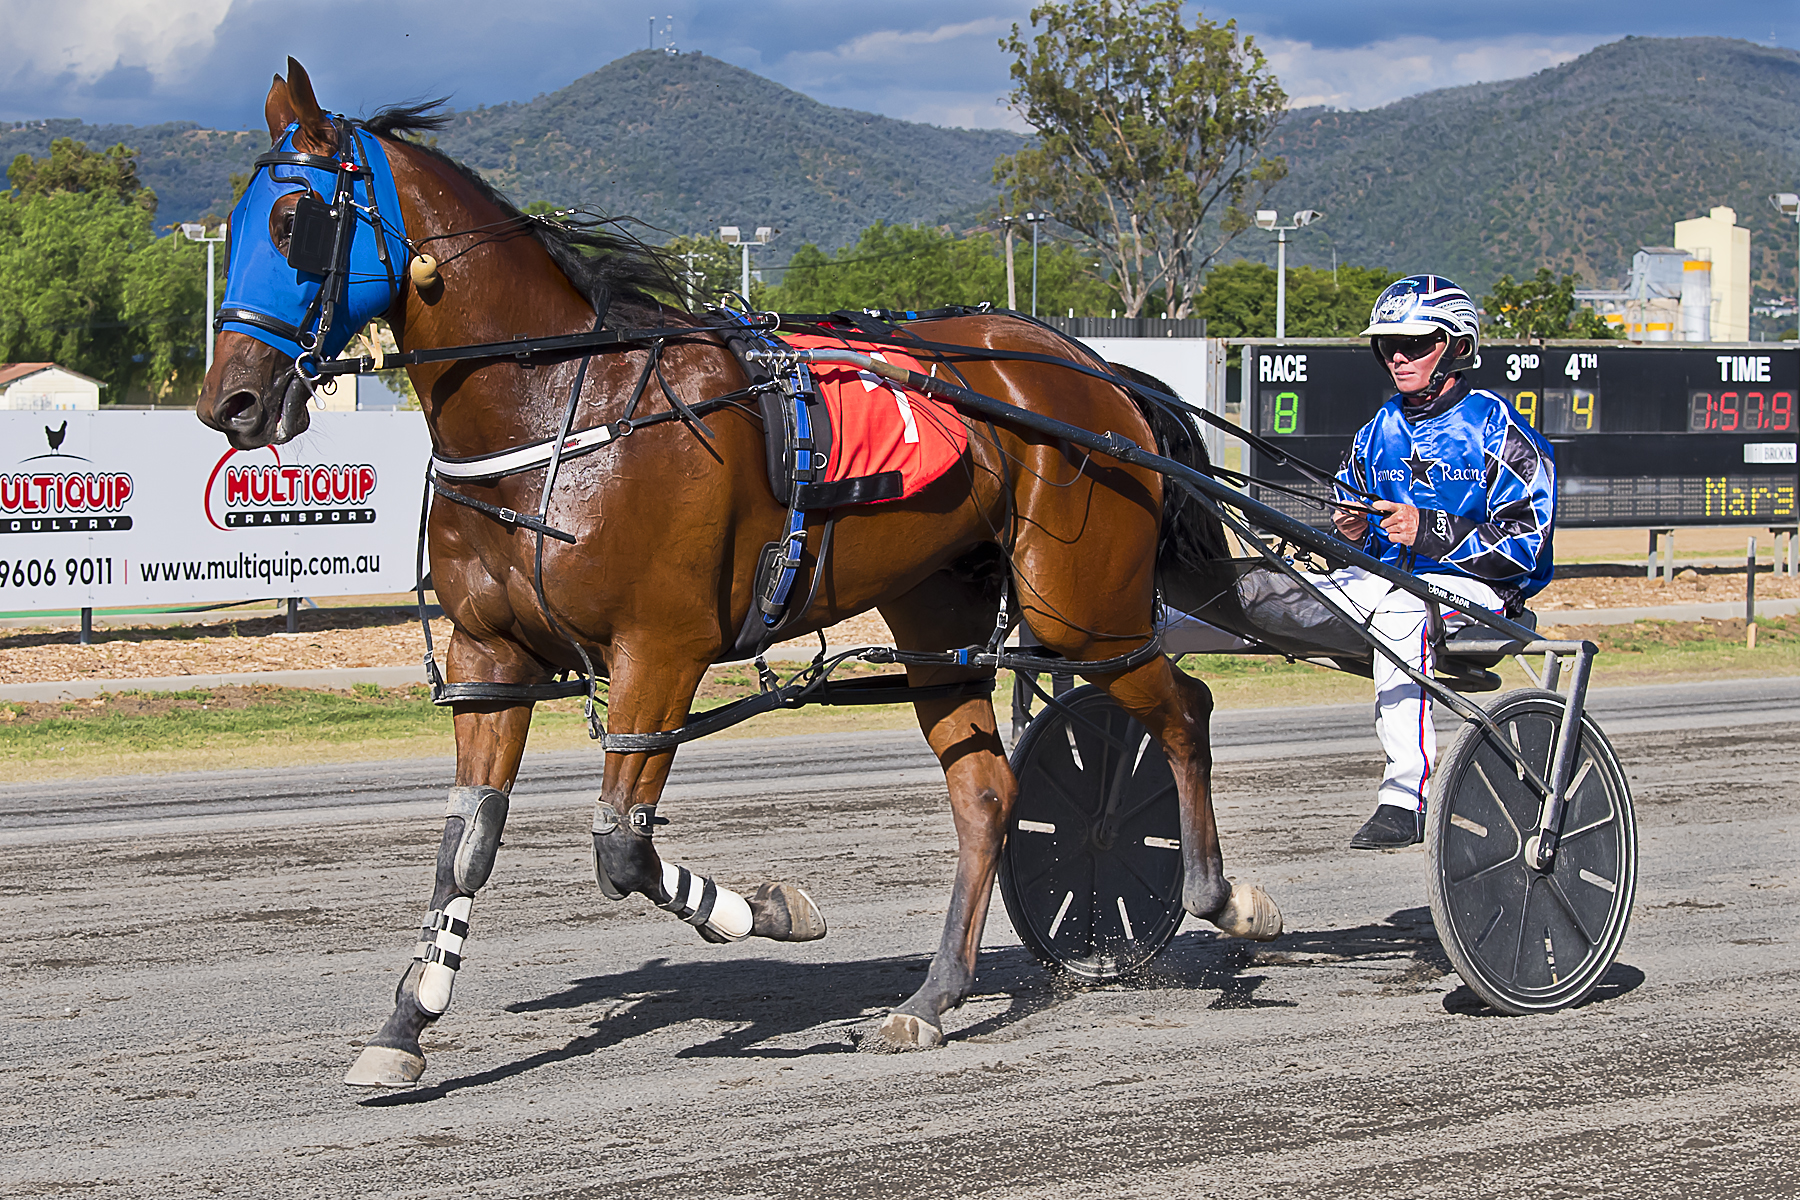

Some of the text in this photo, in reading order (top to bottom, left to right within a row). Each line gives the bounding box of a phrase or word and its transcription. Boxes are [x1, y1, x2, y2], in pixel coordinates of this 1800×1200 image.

[1259, 355, 1307, 382] RACE
[1506, 354, 1540, 381] 3RD
[1564, 353, 1598, 381] 4TH
[1716, 356, 1771, 382] TIME
[1274, 392, 1299, 434] 8
[1573, 393, 1594, 430] 4
[1764, 446, 1794, 461] BROOK
[226, 466, 376, 505] MULTIQUIP
[1440, 462, 1487, 489] Racing
[0, 474, 132, 511] ULTIQUIP
[228, 510, 373, 525] TRANSPORT
[0, 557, 112, 588] 9606 9011
[140, 551, 380, 584] www.multiquip.com.au
